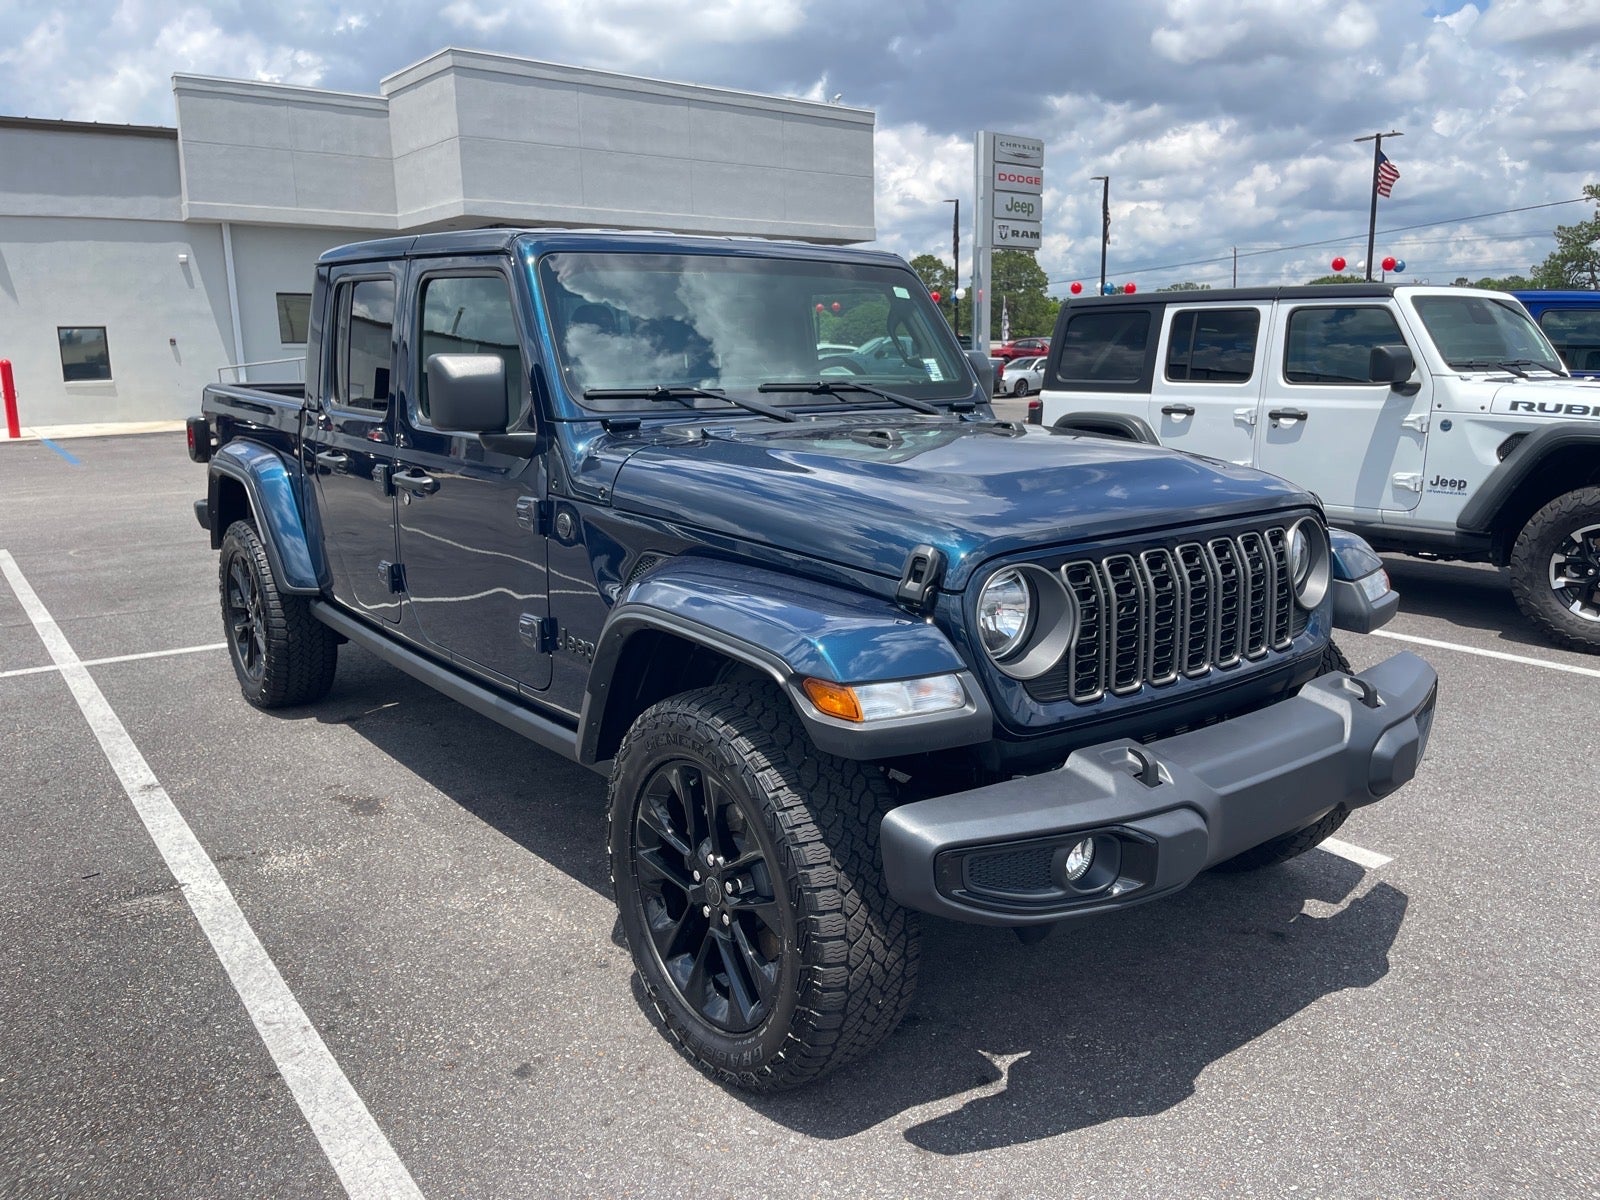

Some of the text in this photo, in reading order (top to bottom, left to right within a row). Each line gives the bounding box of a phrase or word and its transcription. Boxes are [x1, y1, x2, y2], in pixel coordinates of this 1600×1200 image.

[999, 141, 1041, 152] CHRYSLER
[998, 172, 1041, 186] DODGE
[1005, 196, 1034, 217] Jeep
[1011, 229, 1040, 239] RAM
[1430, 475, 1467, 491] Jeep
[557, 627, 595, 662] Jeep
